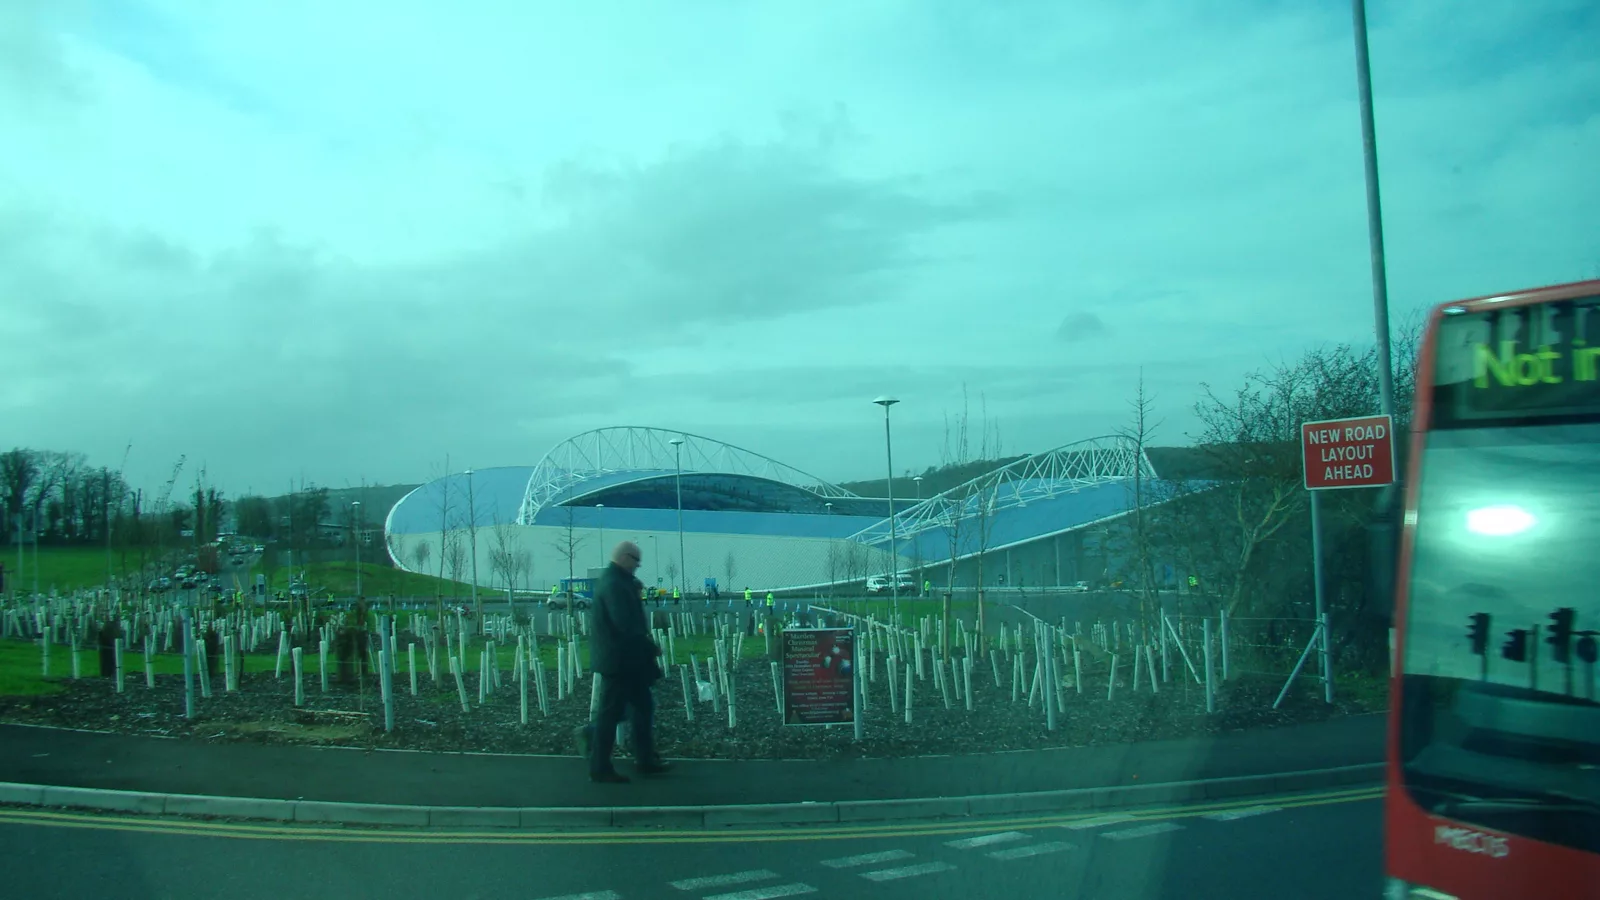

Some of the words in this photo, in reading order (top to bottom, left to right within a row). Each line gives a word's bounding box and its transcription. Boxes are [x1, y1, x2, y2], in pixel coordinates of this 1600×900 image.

[1473, 340, 1563, 388] Not
[1309, 428, 1340, 445] NEW
[1345, 424, 1386, 442] ROAD
[1321, 445, 1375, 462] LAYOUT
[1324, 464, 1373, 481] AHEAD
